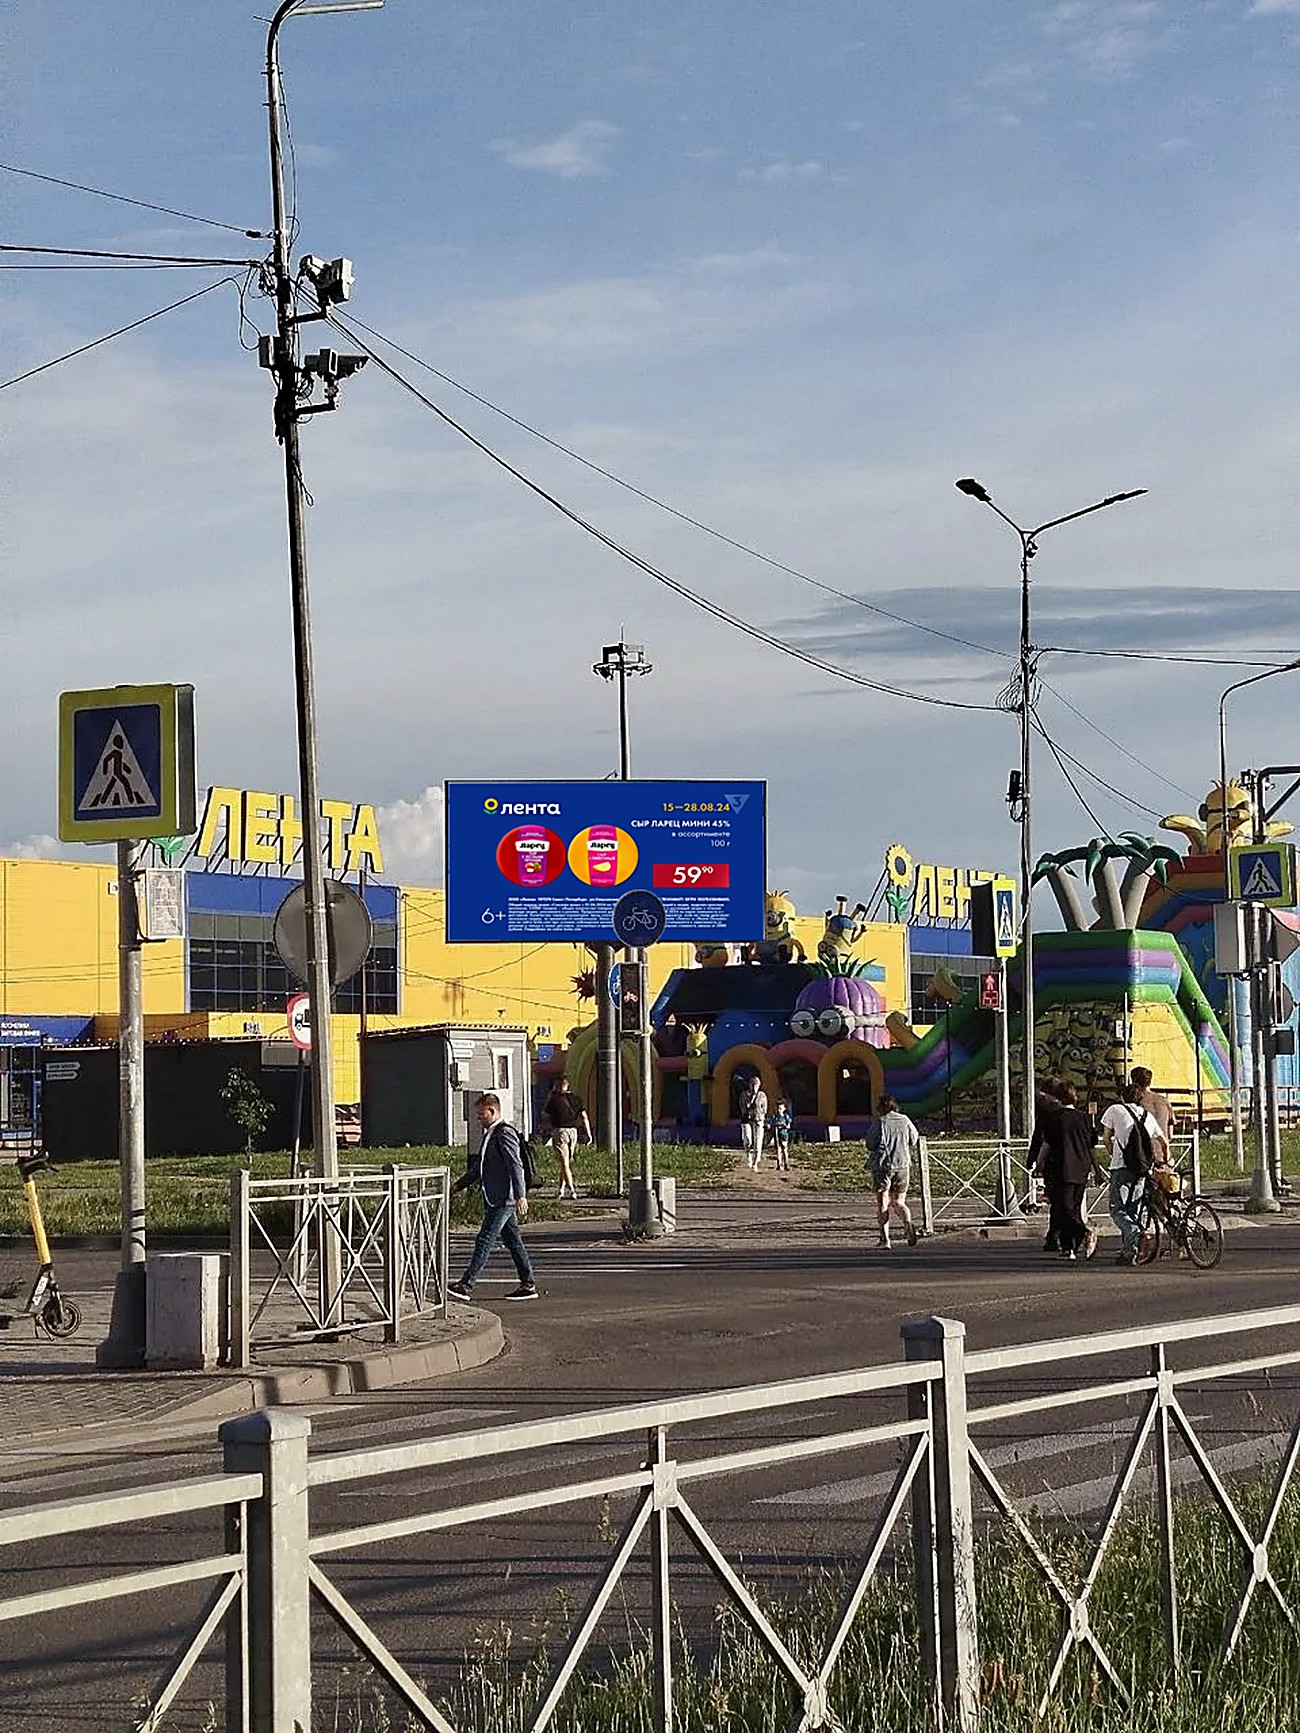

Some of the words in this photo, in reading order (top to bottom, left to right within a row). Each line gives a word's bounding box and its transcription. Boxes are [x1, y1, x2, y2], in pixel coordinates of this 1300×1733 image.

[500, 801, 561, 815] лента
[196, 785, 384, 874] ЛЕНТА
[631, 820, 650, 828] СЫР
[651, 820, 680, 829] ЛАРЕЦ
[682, 820, 711, 828] МИНИ
[712, 820, 731, 828] 45%
[677, 831, 731, 839] ассортименте
[913, 864, 1007, 918] ЛЕН
[481, 908, 506, 924] 6+
